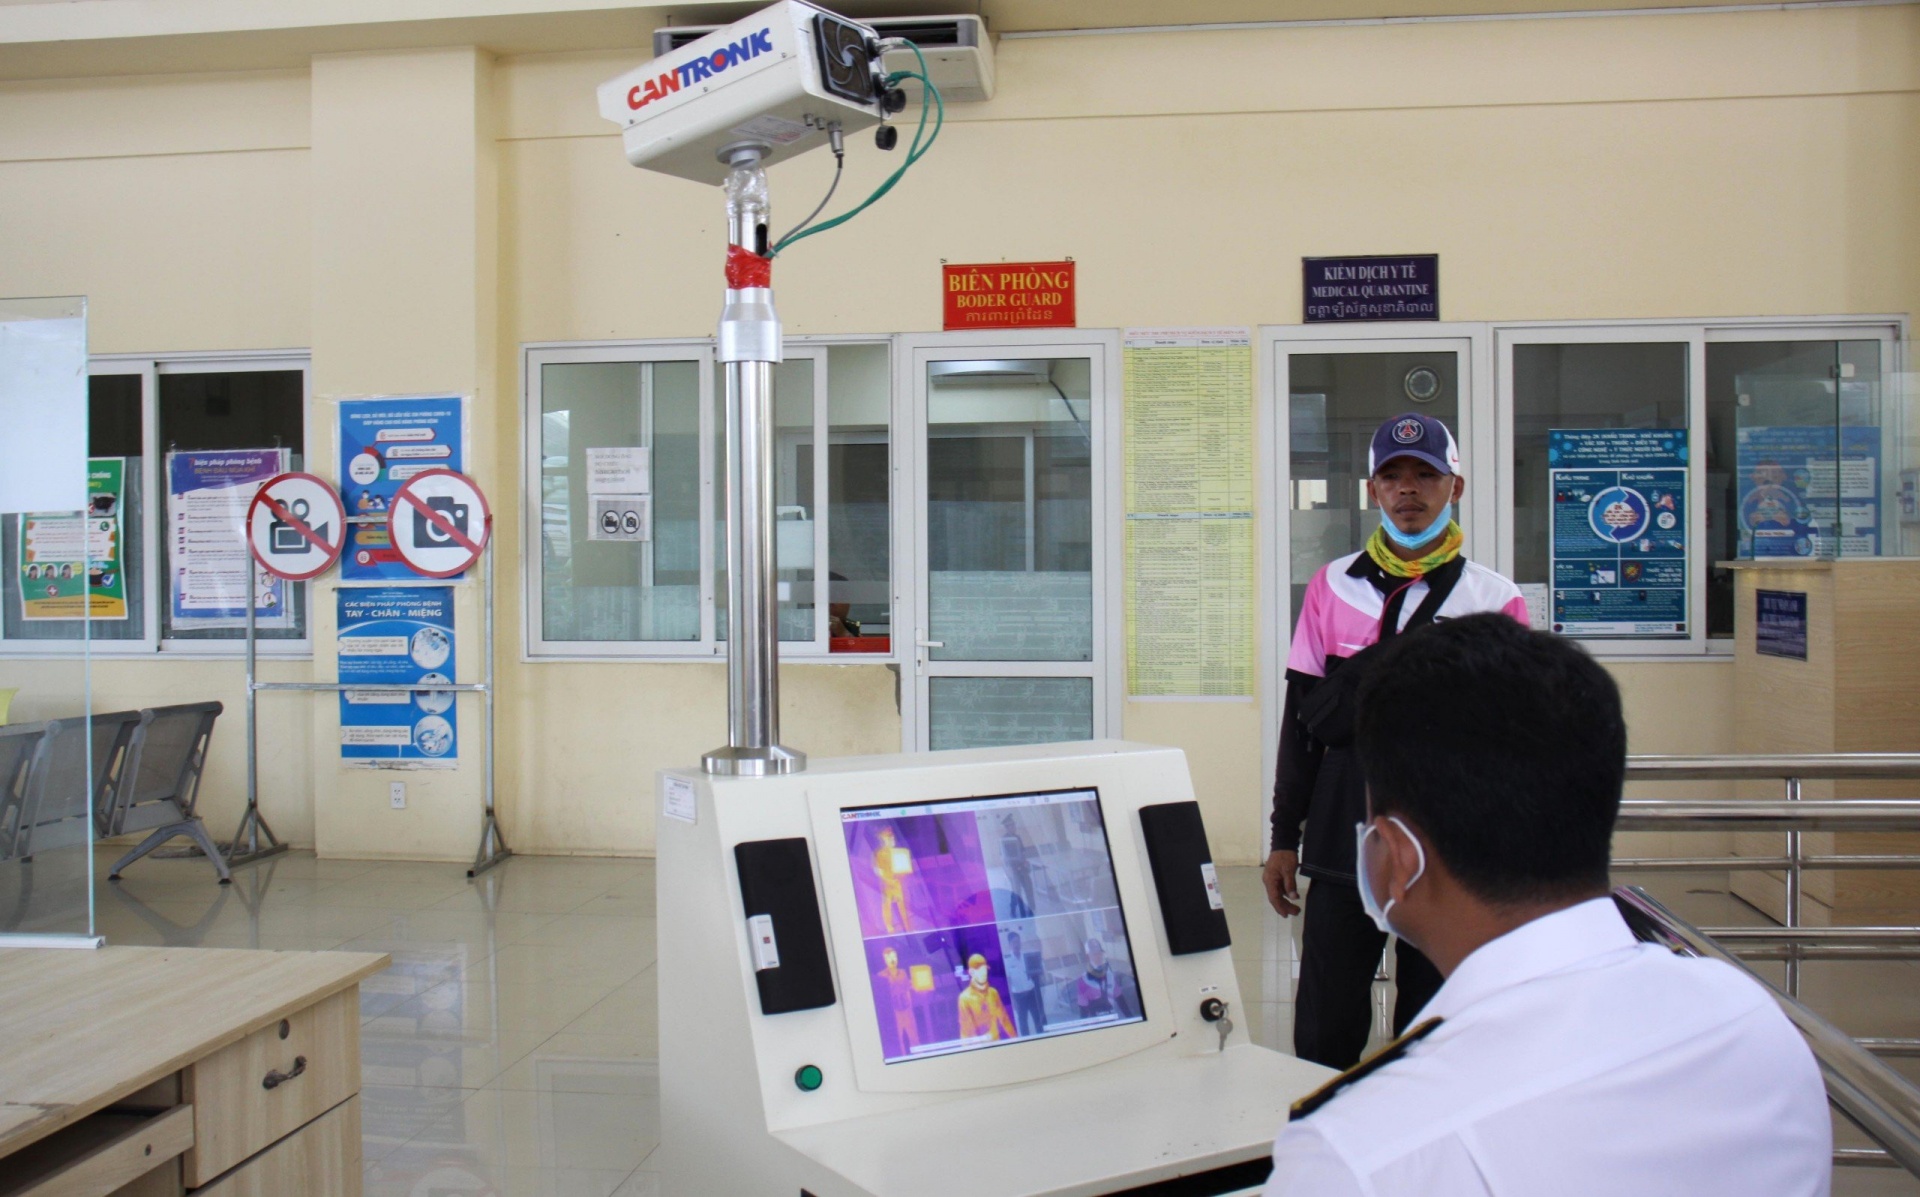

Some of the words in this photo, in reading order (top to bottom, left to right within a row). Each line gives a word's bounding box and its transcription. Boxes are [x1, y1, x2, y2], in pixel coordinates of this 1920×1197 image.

[627, 27, 773, 111] CANTRONIC
[948, 267, 995, 292] BIÊN
[1000, 266, 1070, 291] PHÒNG
[1358, 265, 1389, 283] DỊCH
[1390, 265, 1400, 280] Y
[1400, 260, 1417, 279] TẾ
[957, 294, 1007, 308] BODER
[1009, 292, 1062, 307] GUARD
[1312, 286, 1360, 298] MEDICAL
[1361, 284, 1430, 299] QUARANTINE
[371, 608, 400, 617] CHÂN
[408, 608, 443, 618] MIỆNG
